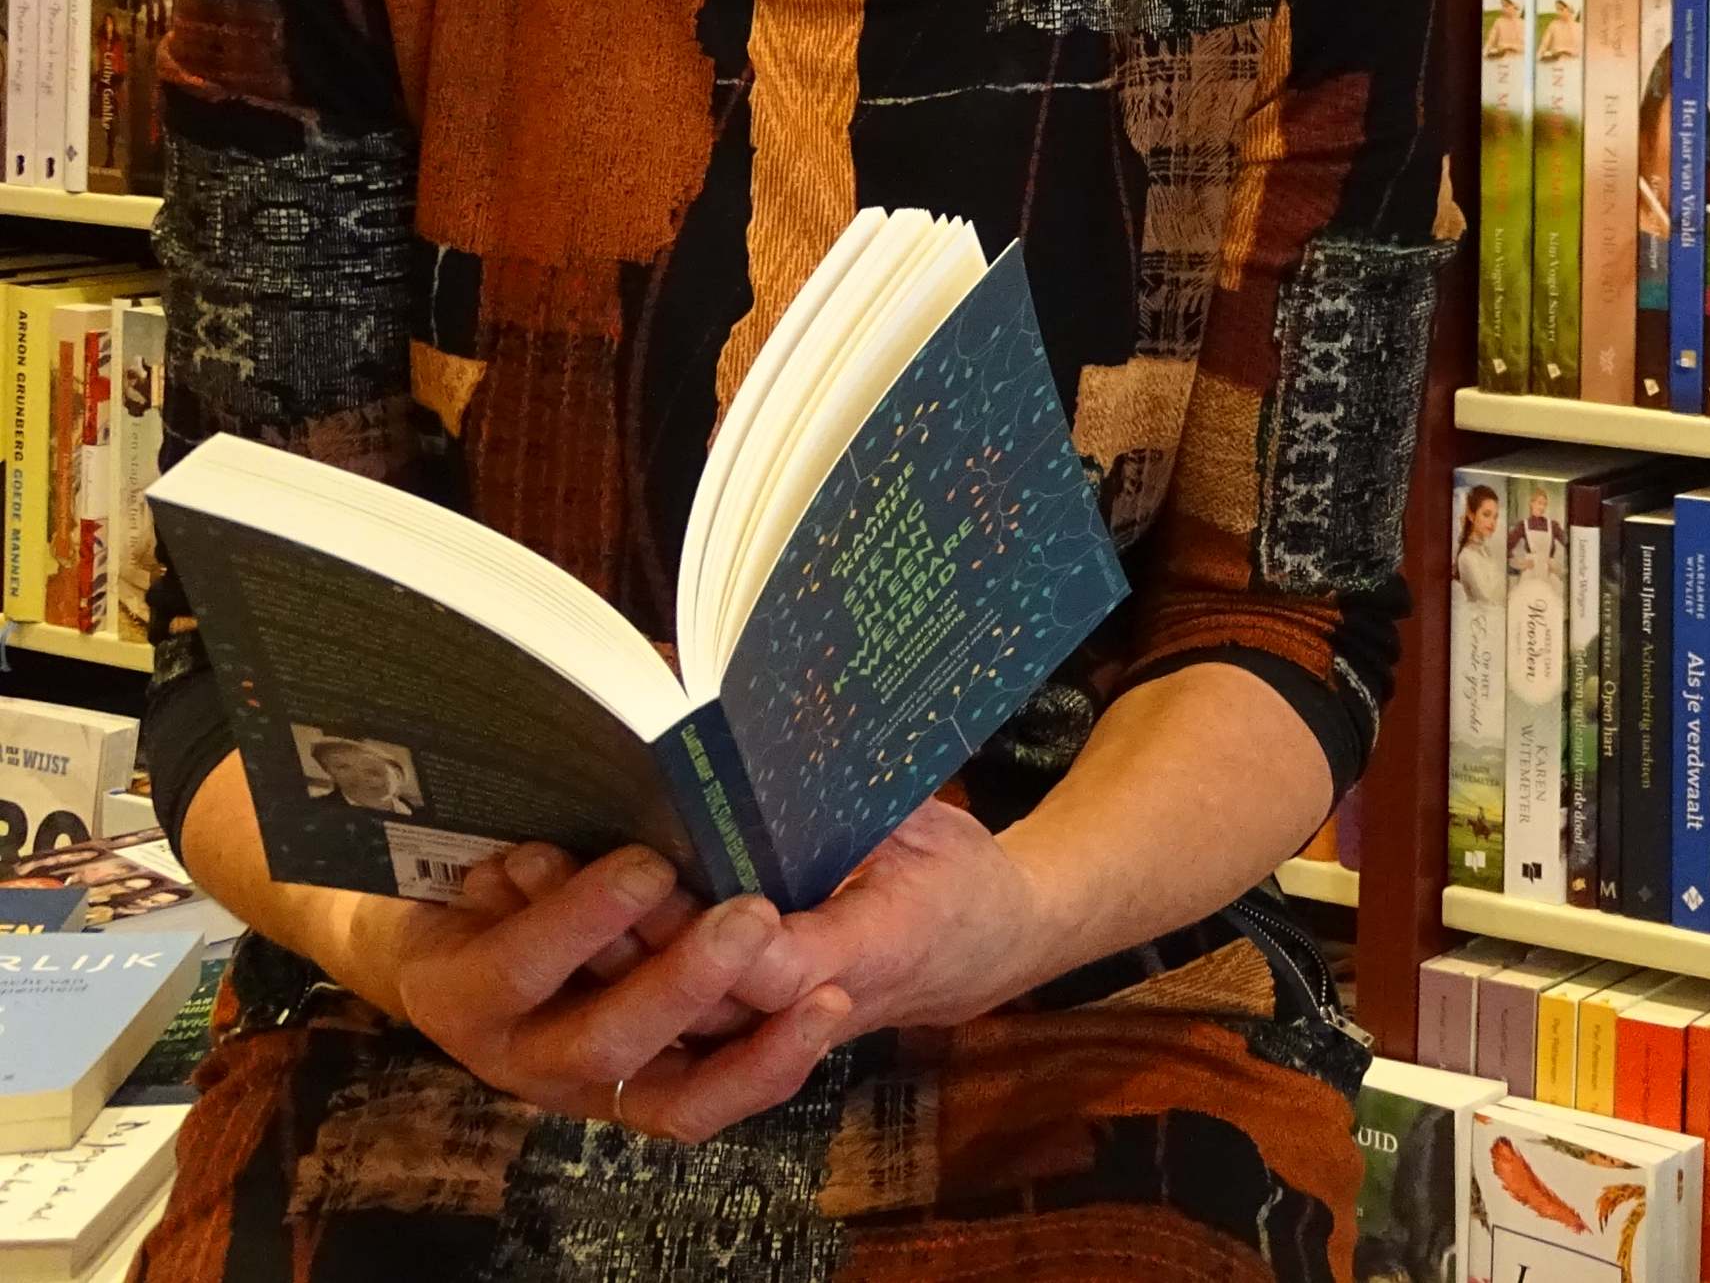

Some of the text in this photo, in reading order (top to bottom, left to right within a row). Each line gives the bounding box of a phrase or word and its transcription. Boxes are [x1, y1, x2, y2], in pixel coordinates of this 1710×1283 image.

[23, 749, 70, 775] WIJST
[1682, 652, 1706, 831] Als je verdwaalt
